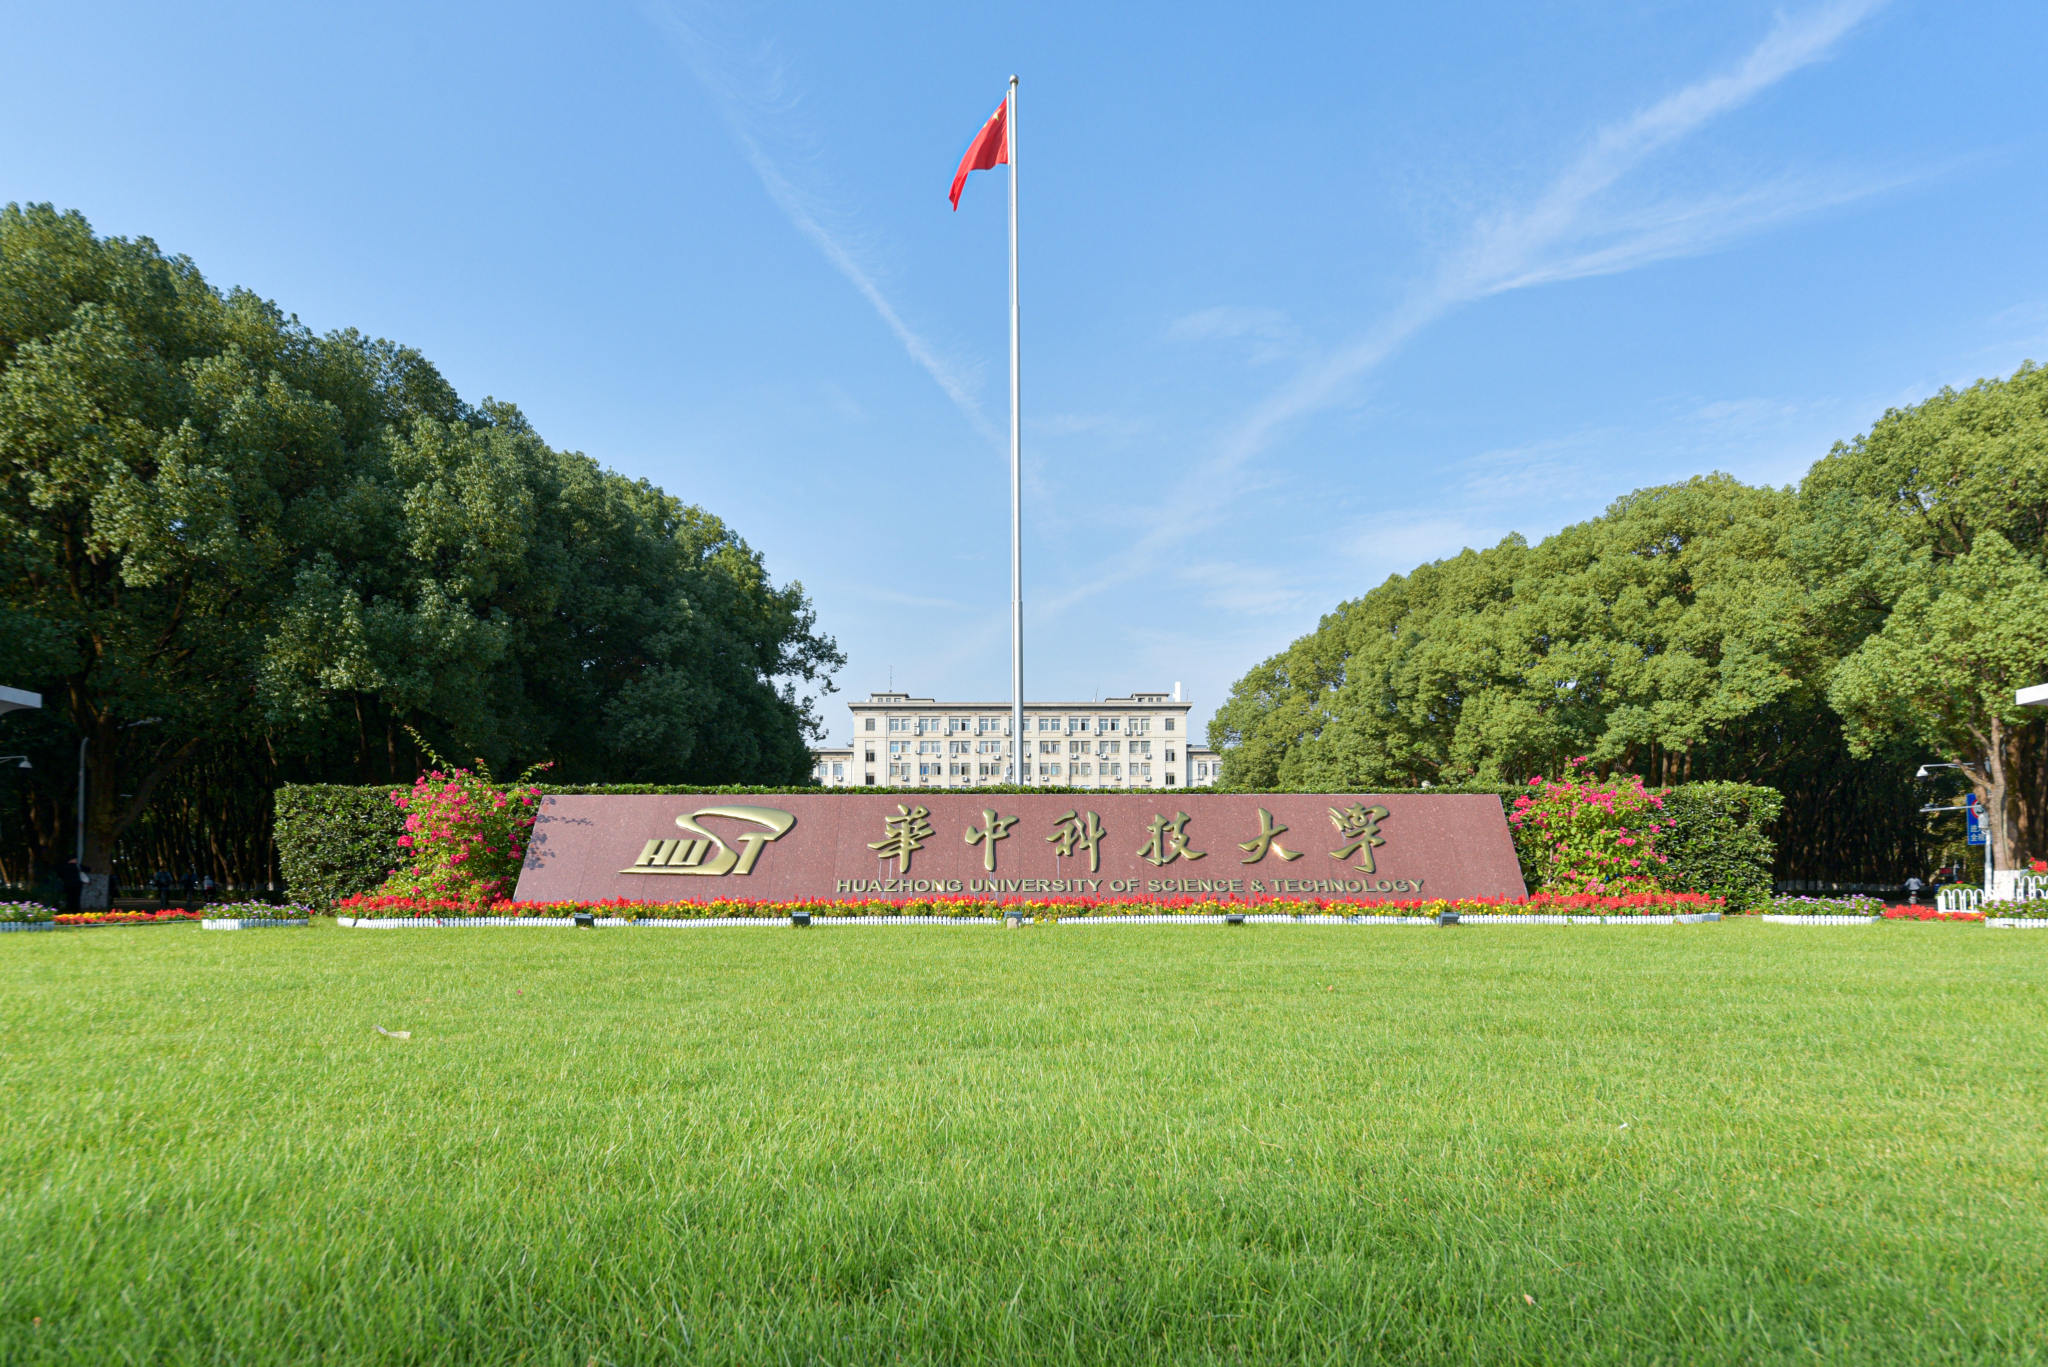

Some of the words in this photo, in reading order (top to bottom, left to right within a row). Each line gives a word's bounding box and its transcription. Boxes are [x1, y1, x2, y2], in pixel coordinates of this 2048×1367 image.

[618, 805, 797, 876] HUST
[836, 879, 963, 893] HUAZHONG
[969, 879, 1103, 893] UNIVERSITY
[1110, 879, 1139, 893] OF
[1148, 879, 1244, 893] SCIENCE
[1250, 879, 1266, 893] &
[1270, 879, 1424, 893] TECHNOLOGY
